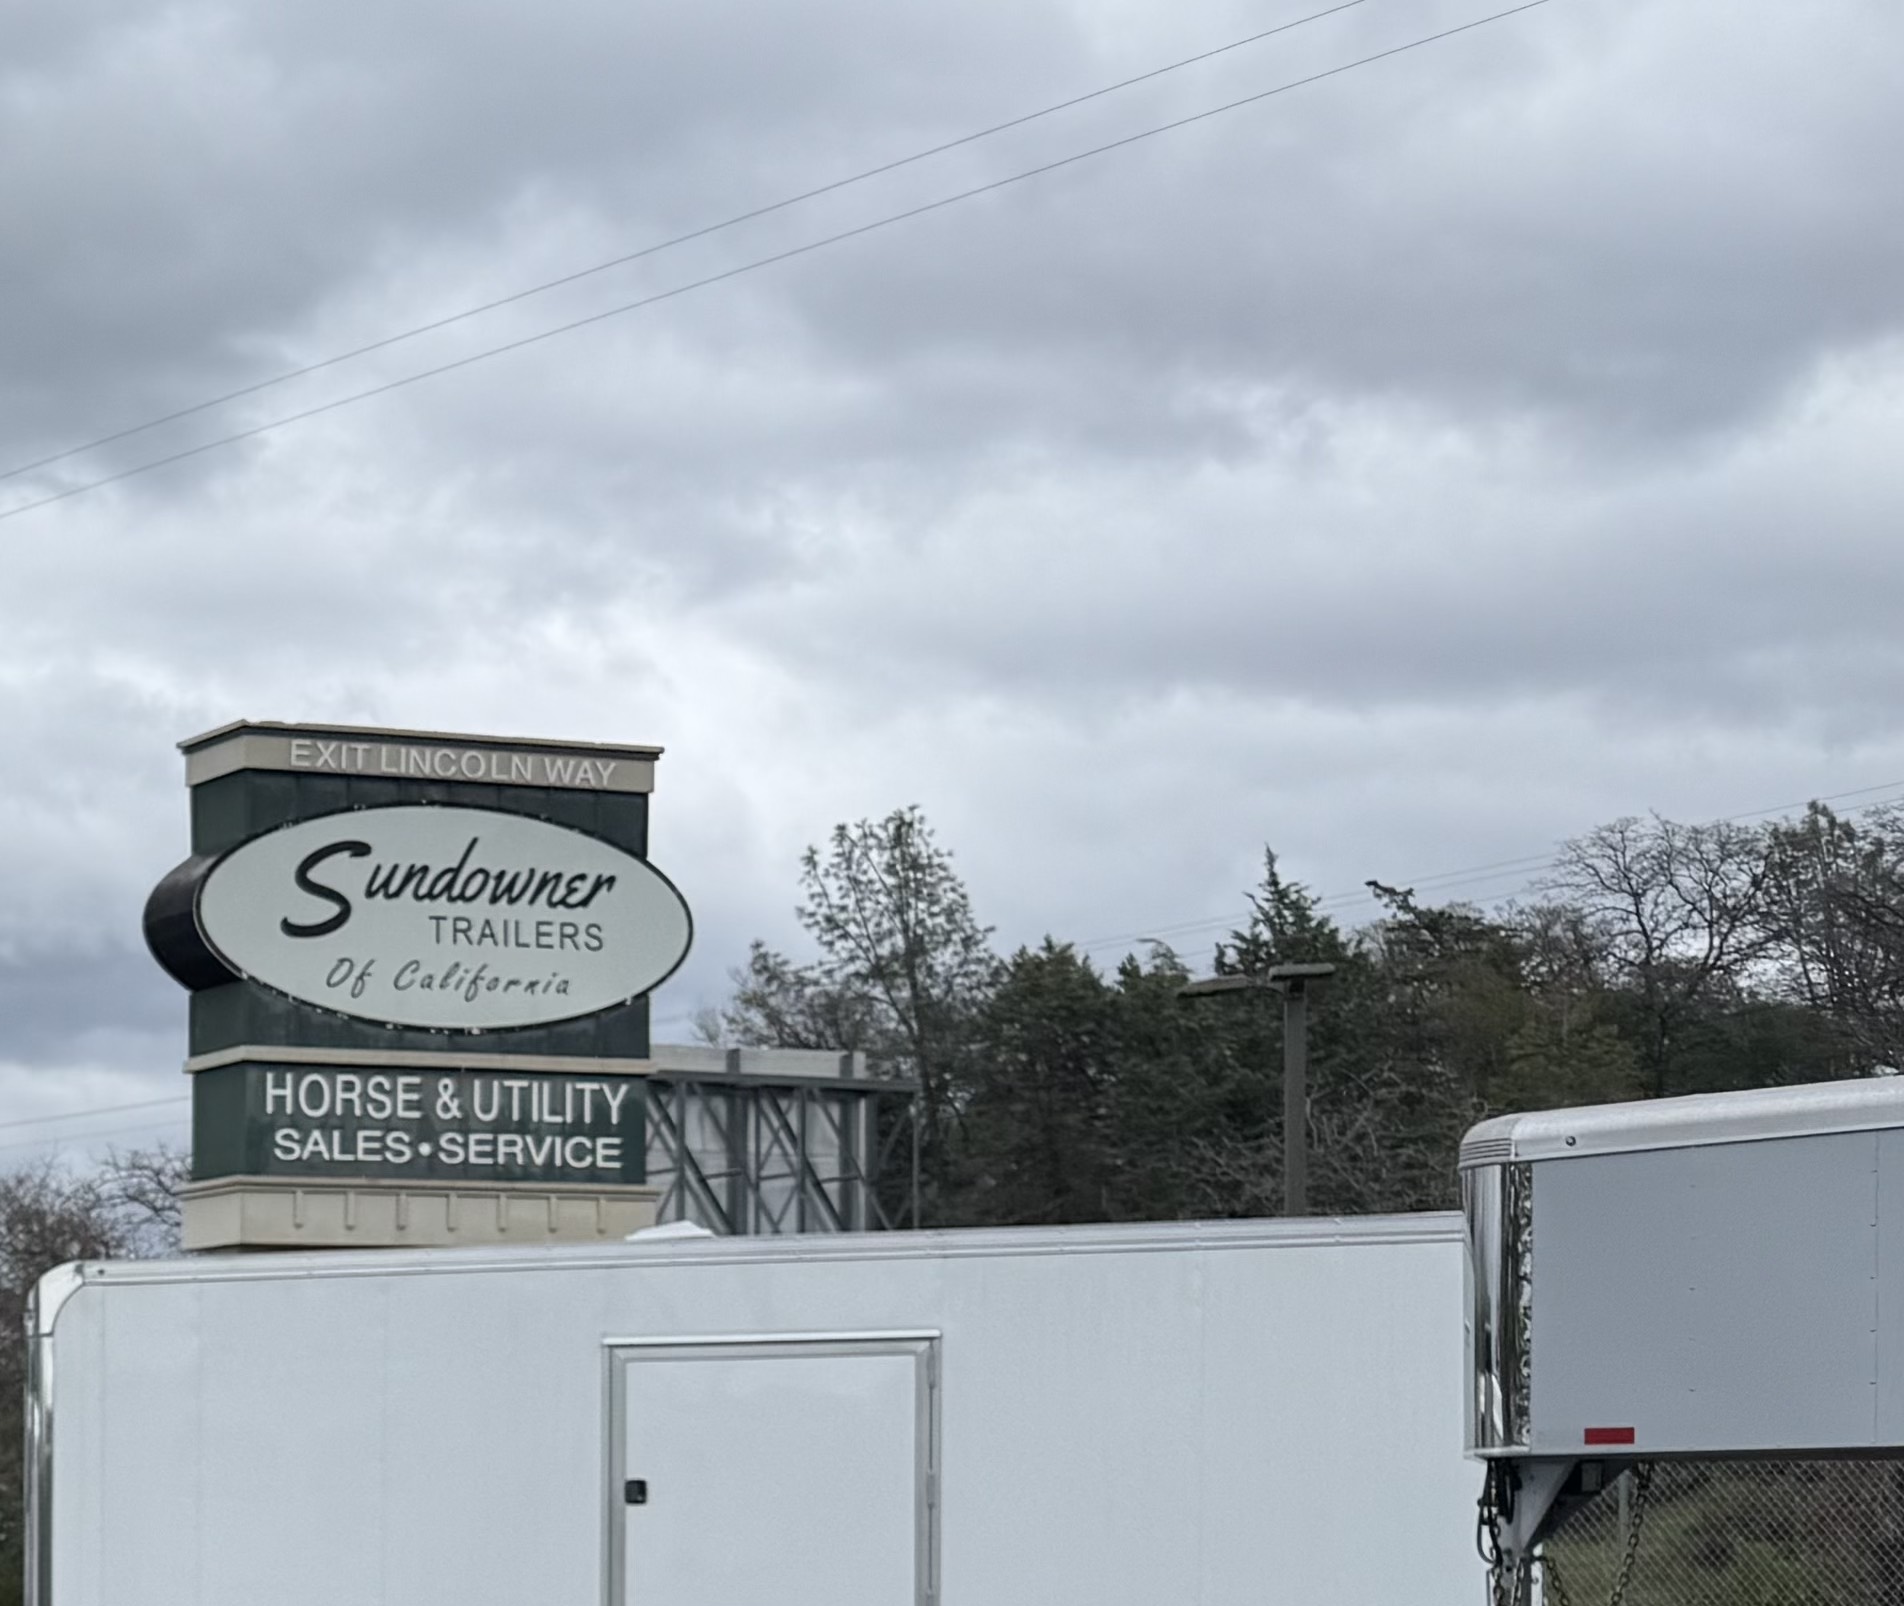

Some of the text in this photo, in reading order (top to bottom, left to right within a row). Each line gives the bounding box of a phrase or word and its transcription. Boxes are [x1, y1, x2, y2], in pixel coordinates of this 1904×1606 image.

[289, 738, 618, 786] EXIT LINCOLN WAY
[280, 836, 617, 938] Sundowner
[428, 915, 605, 952] TRAILERS
[325, 957, 571, 1002] Of California
[264, 1071, 630, 1126] HORSE & UTILITY
